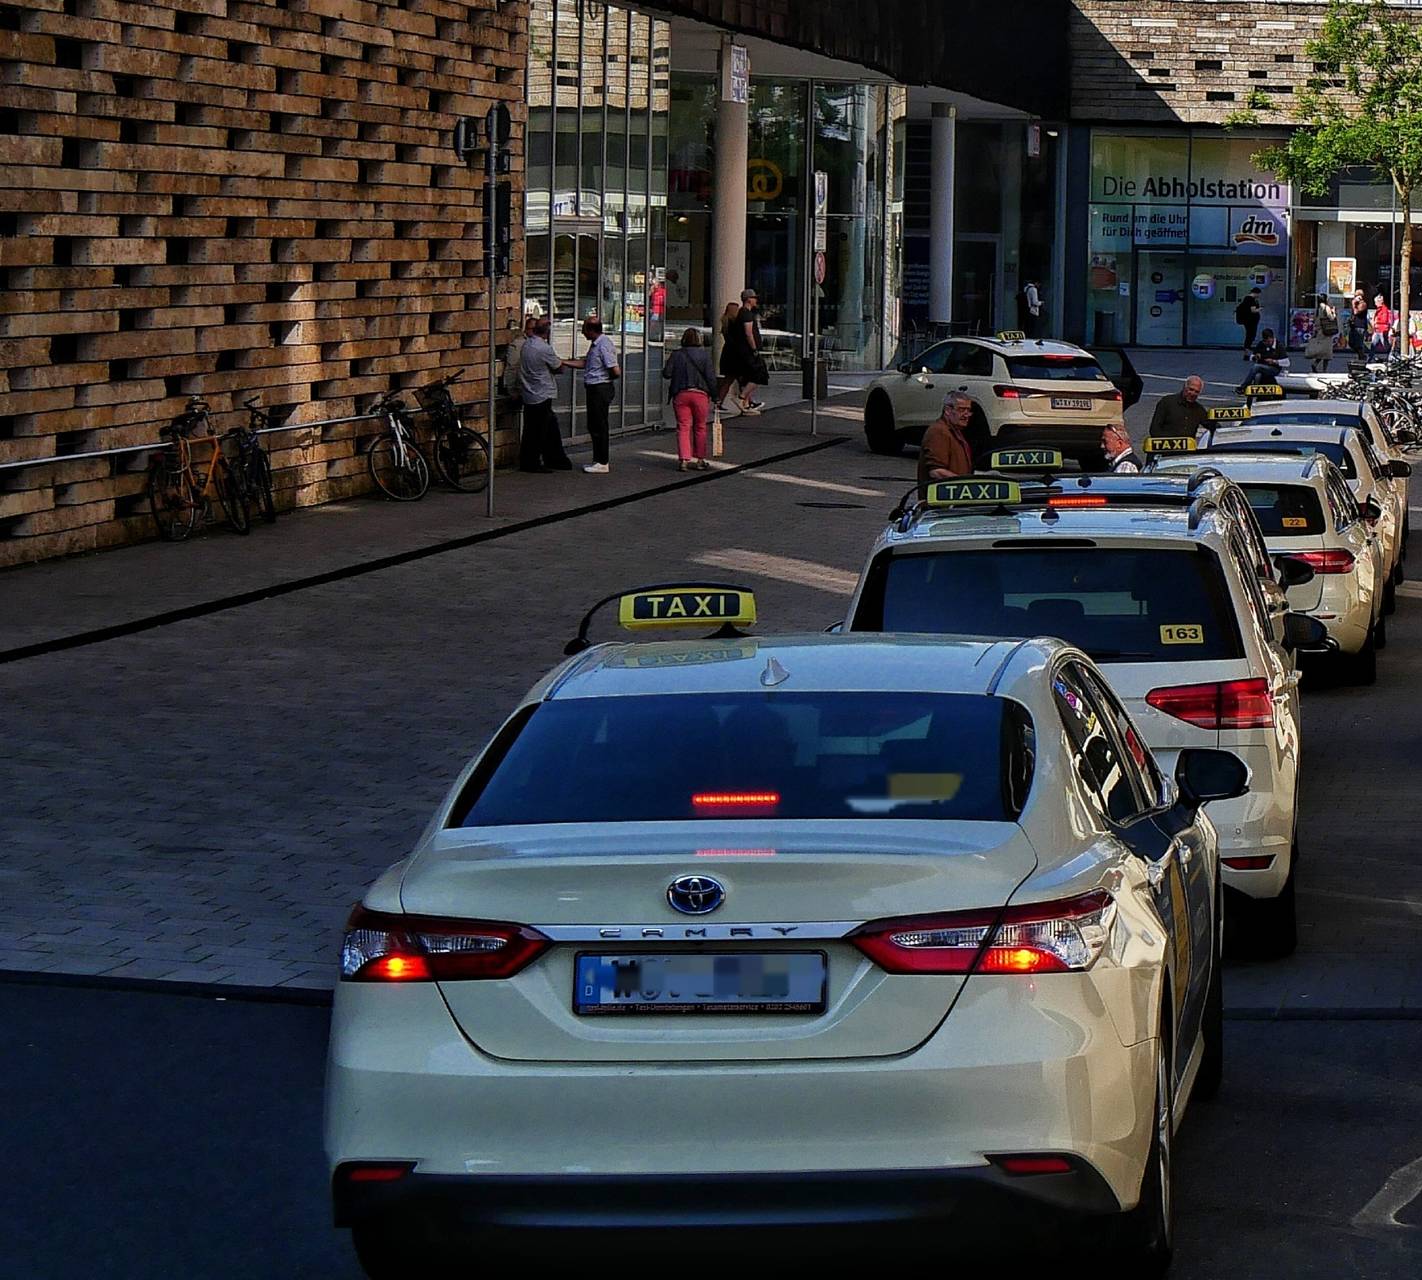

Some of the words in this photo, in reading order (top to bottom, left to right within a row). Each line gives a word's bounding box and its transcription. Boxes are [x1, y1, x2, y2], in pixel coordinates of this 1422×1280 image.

[1102, 176, 1137, 197] Die
[1142, 177, 1280, 200] Abholstation
[1102, 213, 1129, 224] Rund
[1150, 214, 1166, 225] die
[1168, 213, 1187, 225] Uhr
[1241, 216, 1273, 235] dm
[1102, 226, 1117, 237] für
[1144, 228, 1188, 240] geöffnet
[1216, 408, 1244, 417] TAXI
[1154, 440, 1188, 449] TAXI
[1005, 453, 1047, 464] TAXI
[945, 483, 1000, 500] TAXI
[647, 595, 725, 617] TAXI
[1165, 628, 1199, 639] 163
[600, 927, 798, 938] CAMRY
[585, 985, 593, 996] D
